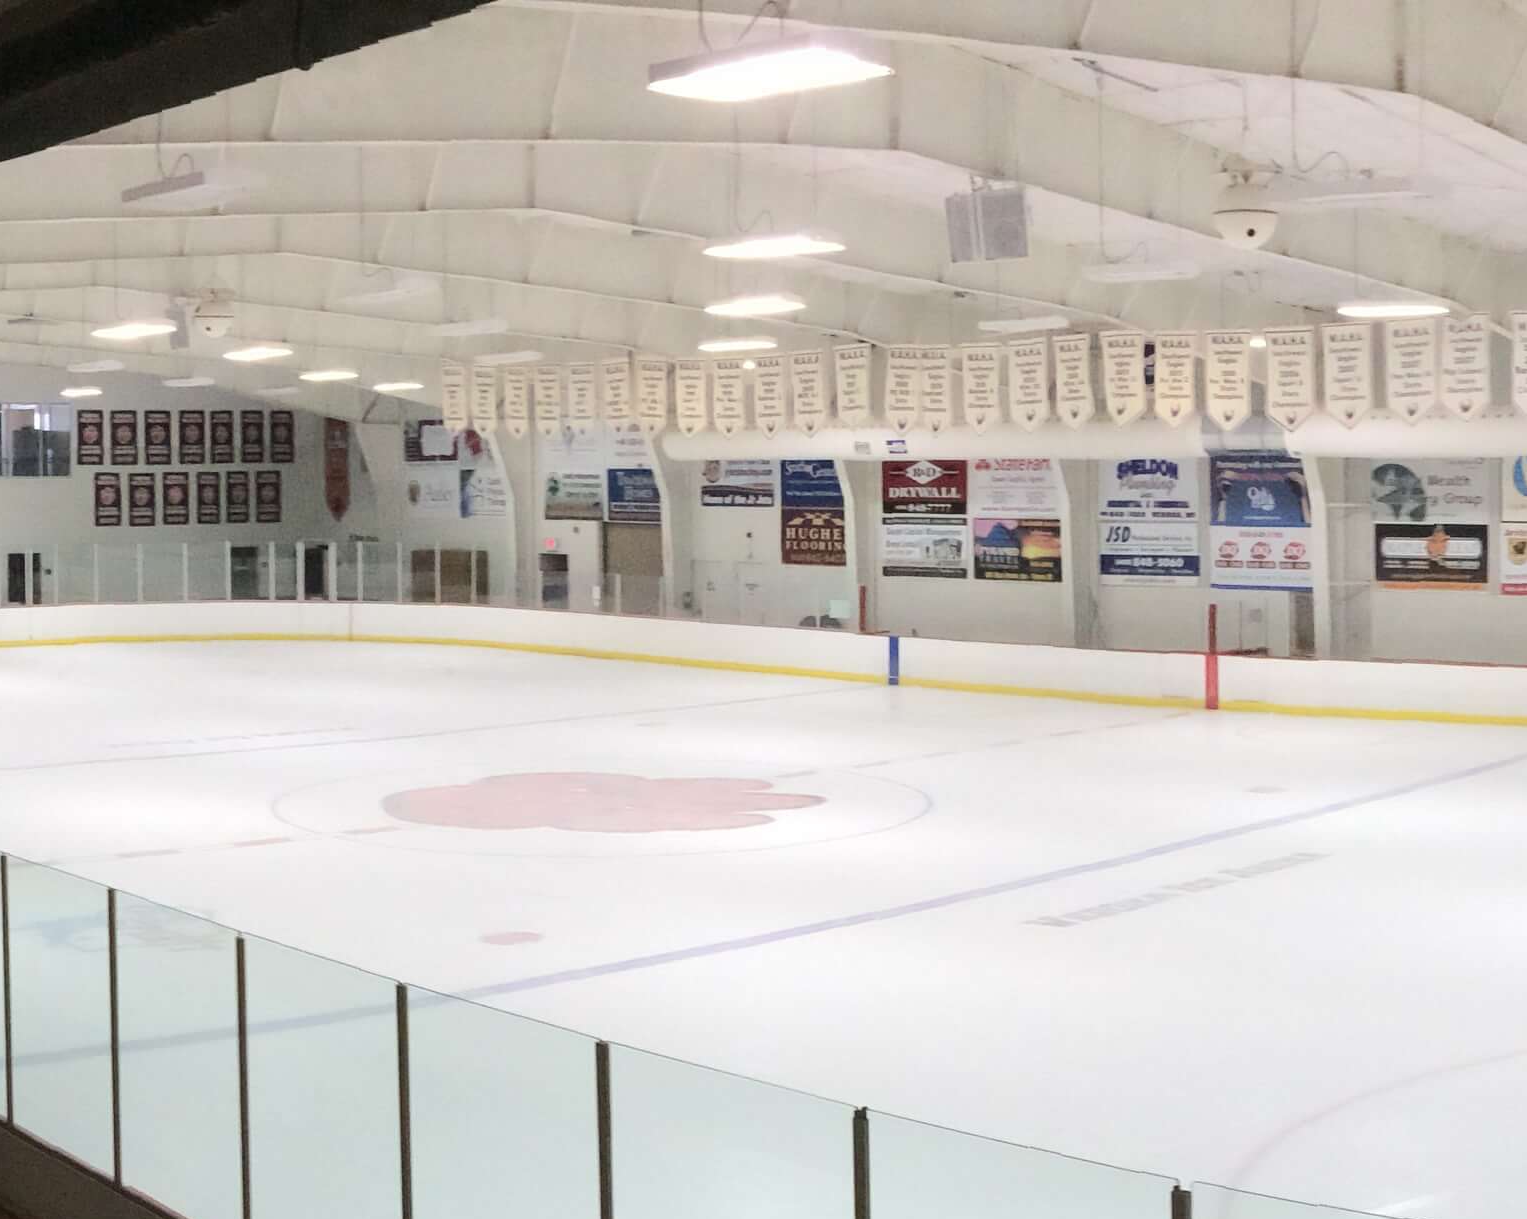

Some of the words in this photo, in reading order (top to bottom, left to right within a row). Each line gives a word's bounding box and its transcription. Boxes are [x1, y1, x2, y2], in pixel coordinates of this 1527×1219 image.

[1116, 459, 1179, 481] SHELDON
[888, 486, 961, 499] DRYWALL
[1443, 492, 1484, 507] Group
[786, 528, 843, 540] HUGHE
[1106, 526, 1131, 543] JSD
[786, 540, 845, 550] FLOORIN
